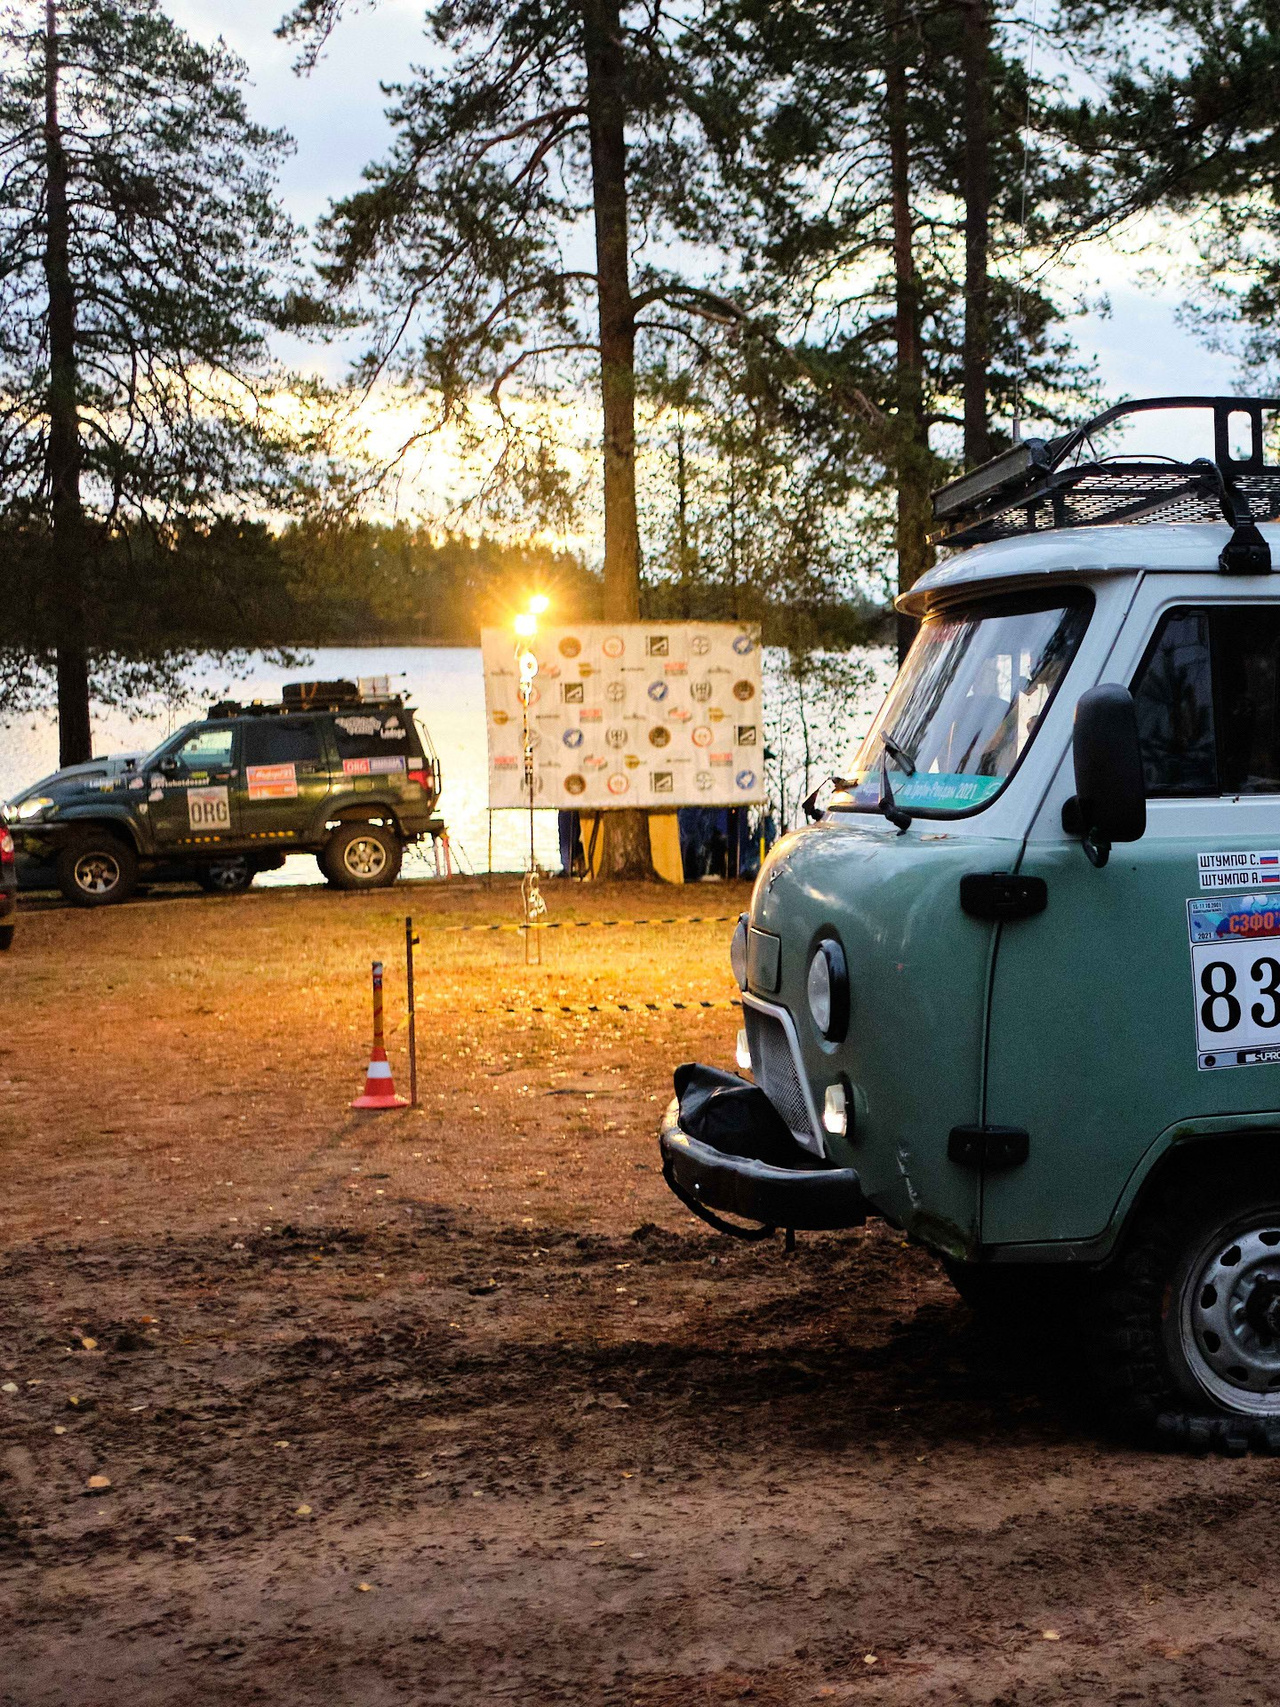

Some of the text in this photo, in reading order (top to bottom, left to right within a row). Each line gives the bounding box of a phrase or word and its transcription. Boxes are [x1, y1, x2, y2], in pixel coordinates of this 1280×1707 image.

[956, 783, 978, 800] 2021
[190, 801, 228, 824] ORG
[1200, 854, 1260, 868] ШТУМПФ С.
[1201, 872, 1262, 887] ШТУМПФ А.
